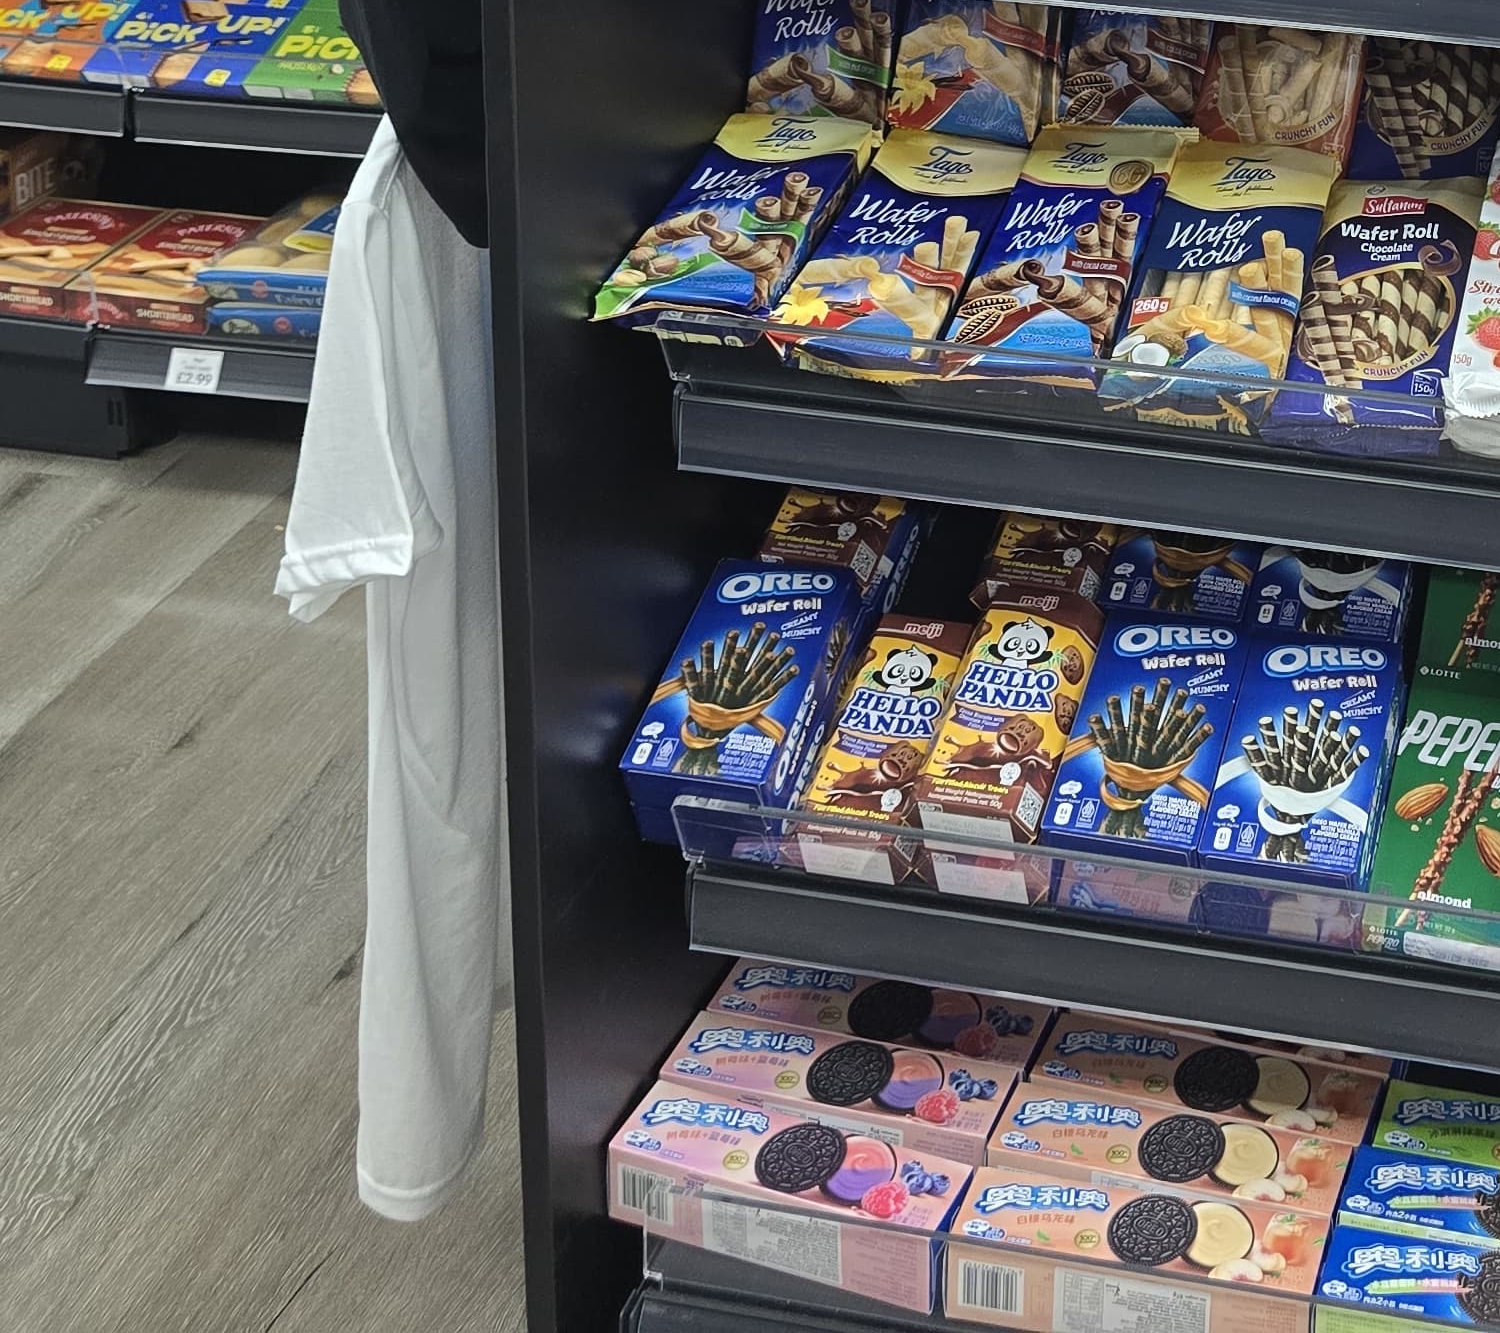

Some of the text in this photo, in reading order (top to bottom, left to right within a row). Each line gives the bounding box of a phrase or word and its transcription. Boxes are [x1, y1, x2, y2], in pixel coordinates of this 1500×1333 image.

[217, 15, 289, 35] UP!
[1222, 157, 1276, 187] Tago
[1166, 214, 1263, 250] Wafer
[1341, 223, 1439, 242] Wafer Roll
[1178, 239, 1253, 270] Rolls
[1360, 242, 1414, 254] Chocolate
[1370, 253, 1401, 261] Cream
[1134, 298, 1169, 314] 260g
[717, 571, 837, 602] OREO
[741, 599, 788, 616] Wafer
[904, 621, 943, 639] meiji
[1115, 624, 1235, 657] OREO
[1264, 644, 1387, 677] OREO
[967, 660, 1058, 691] HELLO
[1292, 677, 1343, 691] Wafer
[854, 688, 942, 718] HELLO
[955, 680, 1051, 711] PANDA
[840, 707, 935, 737] PANDA
[644, 1099, 770, 1133] 奥利奥
[1016, 1098, 1142, 1127] 奥利奥
[1368, 1164, 1499, 1193] 奥利奥
[975, 1184, 1110, 1212] 奥利奥
